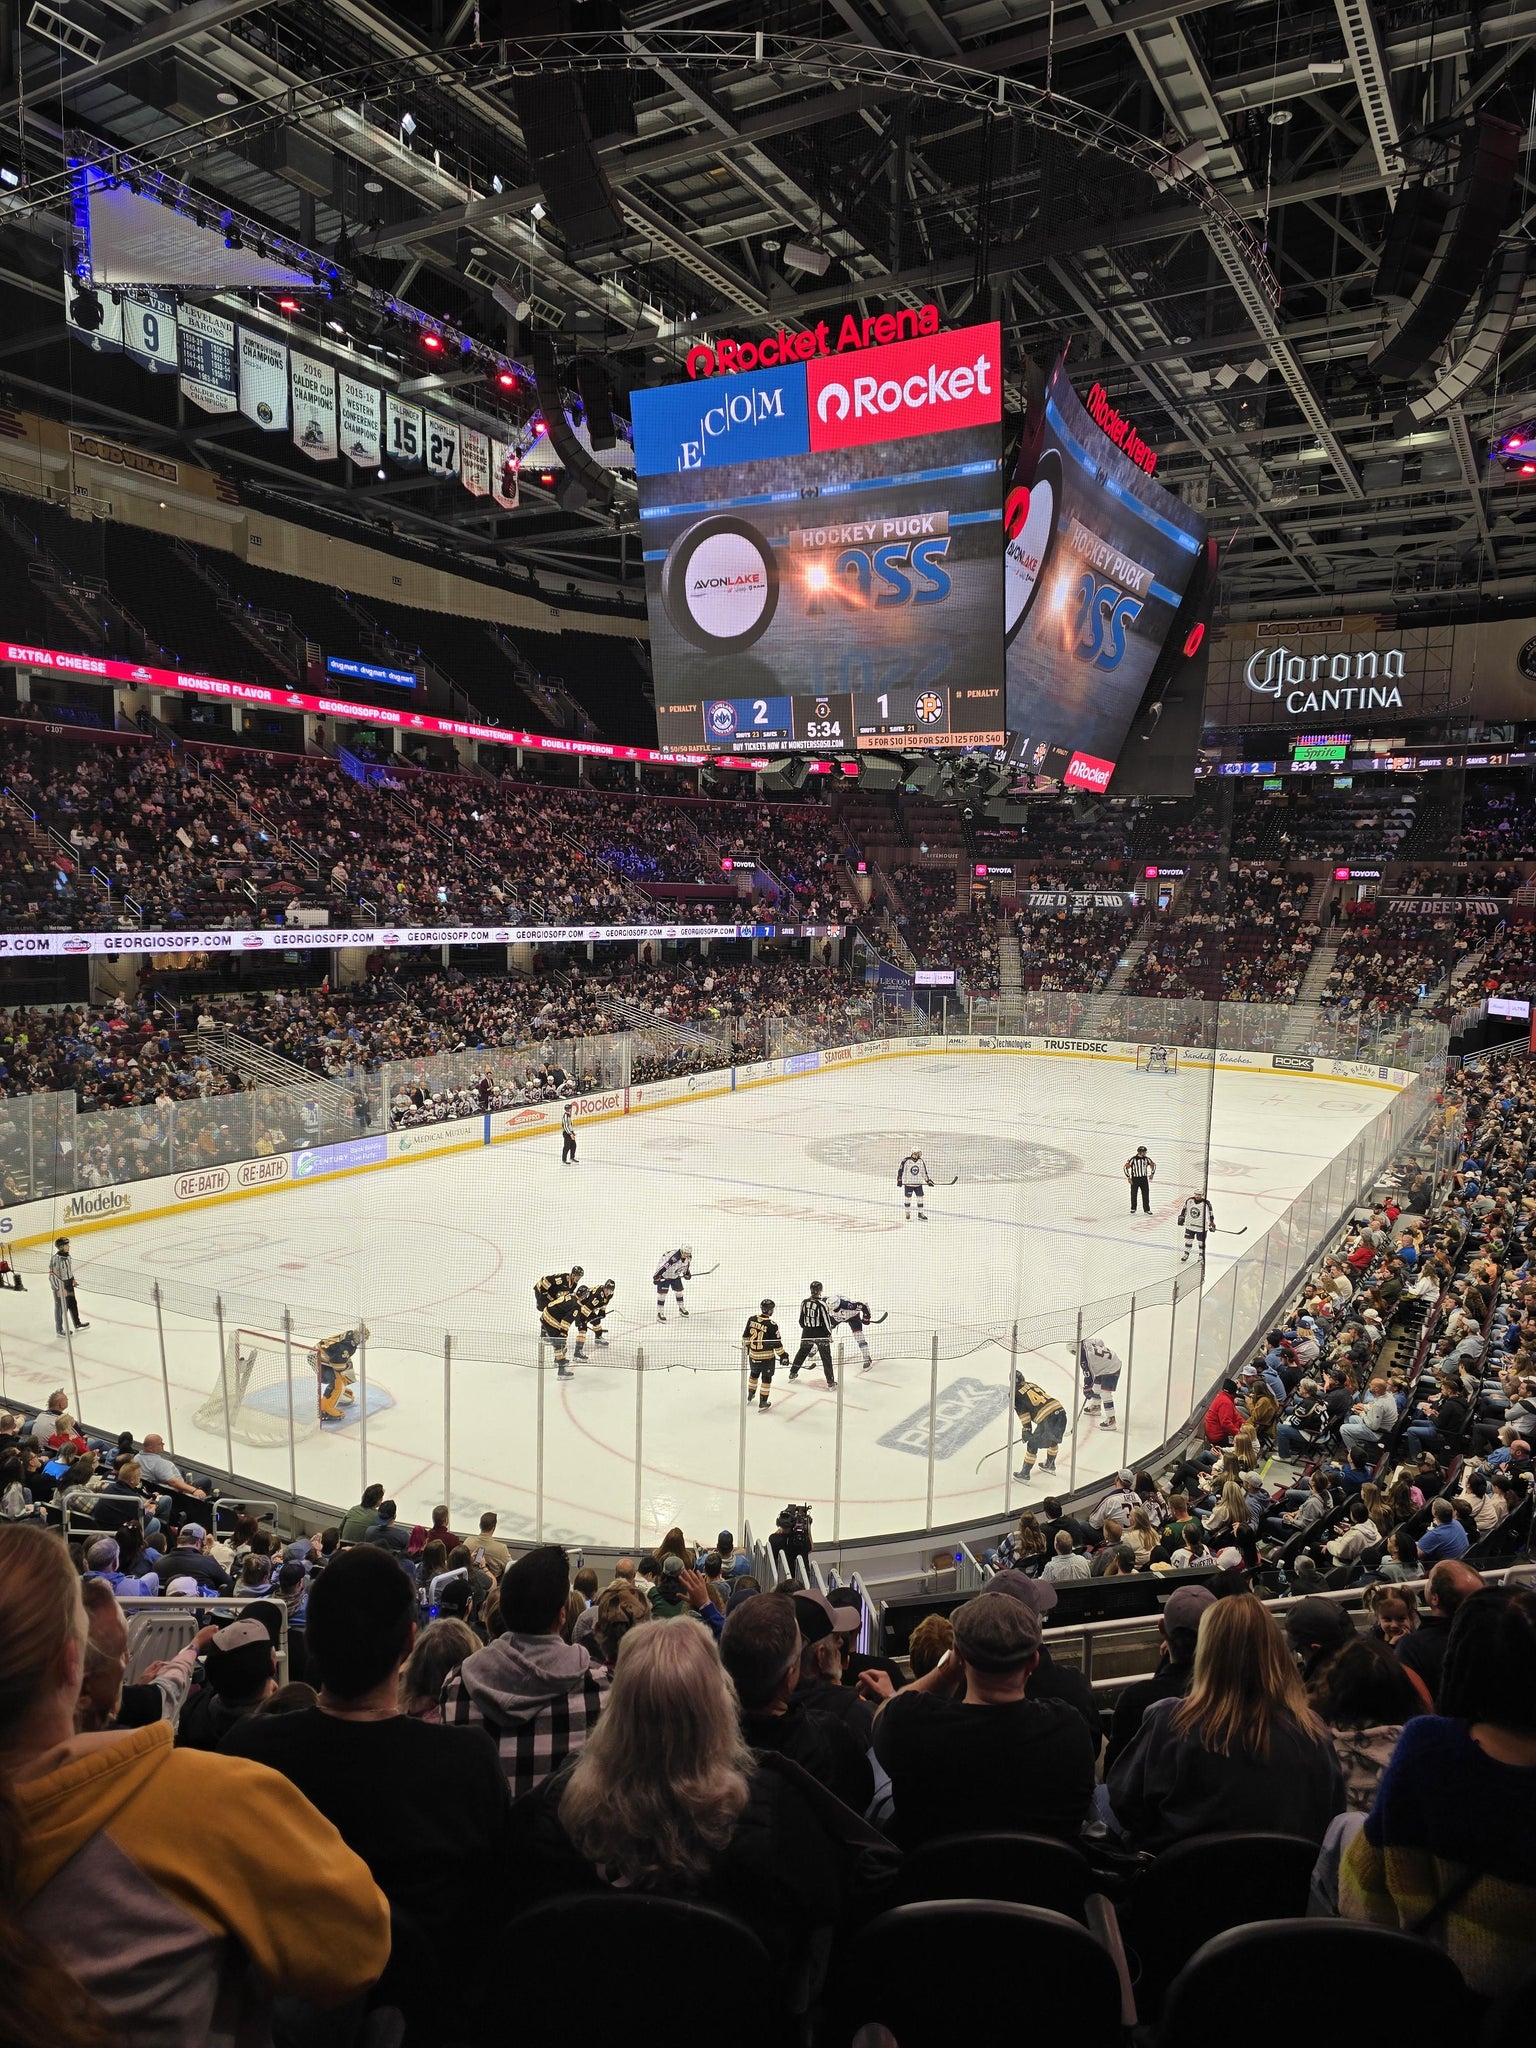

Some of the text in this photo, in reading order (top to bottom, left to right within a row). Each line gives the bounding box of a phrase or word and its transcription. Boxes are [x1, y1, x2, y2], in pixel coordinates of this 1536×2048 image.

[180, 305, 232, 332] CLEVELAND
[188, 317, 225, 338] BARONS
[142, 313, 159, 352] 9
[717, 303, 939, 375] Rocket Arena
[242, 345, 284, 370] CHAMPIONS
[303, 363, 322, 379] 2016
[189, 385, 229, 403] CALDER CUP
[293, 373, 333, 397] CALDER CUP
[345, 383, 375, 404] 2015-16
[854, 354, 992, 418] Rocket
[190, 391, 229, 410] CHAMPIONS
[294, 387, 333, 411] CHAMPIONS
[346, 398, 374, 416] WESTERN
[342, 408, 379, 431] CONFERENCE
[389, 402, 420, 419] CALLANDER
[344, 420, 377, 441] CHAMPIONS
[393, 417, 417, 455] 15
[1092, 389, 1129, 448] Rocket
[1123, 424, 1159, 475] Arena
[72, 434, 178, 483] LOUDVILLE
[430, 433, 455, 470] 27
[74, 486, 88, 496] 210
[250, 536, 262, 545] 211
[801, 515, 934, 548] HOCKEY PUCK
[1071, 529, 1145, 591] HOCKEY PUCK
[1259, 619, 1341, 636] LOUDVILLE
[8, 646, 107, 674] EXTRA CHEESE
[1243, 644, 1408, 699] Corona
[177, 675, 272, 700] MONSTER FLAVOR
[967, 688, 1000, 698] PENALTY
[669, 704, 697, 713] PENALTY
[877, 693, 889, 719] 1
[1285, 686, 1404, 714] CANTINA
[318, 699, 401, 723] GEORGIOSOFP.COM
[752, 699, 769, 725] 2
[44, 725, 64, 734] C 107
[437, 720, 514, 742] TRY THE MONSTERONI
[807, 721, 841, 738] 5:34
[907, 724, 915, 732] 21
[541, 738, 614, 755] DOUBLE PEPPERONI
[732, 743, 744, 752] BUY
[744, 741, 767, 751] TICKETS
[766, 741, 780, 750] NOW
[780, 740, 788, 748] AT
[868, 733, 1001, 746] 5 FOR $10 50 FOR $20 125 FOR $40
[1020, 738, 1030, 757] 1
[1303, 747, 1336, 759] Sprite
[1077, 762, 1111, 786] Rocket
[1206, 766, 1213, 774] 7
[1250, 763, 1260, 774] 2
[1291, 761, 1317, 772] 5:34
[1371, 758, 1379, 769] 1
[1418, 759, 1442, 767] SHOTS
[1446, 757, 1454, 766] 8
[1466, 757, 1488, 765] SAVES
[1489, 755, 1502, 764] 21
[1350, 870, 1380, 878] TOYOTA
[1029, 894, 1123, 908] THE END
[1388, 900, 1418, 914] THE
[1465, 903, 1500, 916] END
[104, 936, 232, 949] GEORGIOSOFP.COM
[273, 933, 375, 945] GEORGIOSOFP.COM
[407, 931, 490, 942] GEORGIOSOFP.COM
[516, 929, 584, 940] GEORGIOSOFP.COM
[605, 927, 663, 938] GEORGIOSOFP.COM
[680, 926, 735, 937] GEORGIOSOFP.COM
[764, 927, 770, 936] 7
[805, 927, 815, 936] 21
[996, 1038, 1032, 1049] Technologies
[1044, 1039, 1108, 1053] TRUSTEDSEC
[825, 1049, 852, 1064] SEATGEEK
[1182, 1049, 1215, 1061] Sandals
[1350, 1065, 1376, 1078] BARONS
[580, 1093, 620, 1115] Rocket
[514, 1113, 540, 1124] SERVPRO
[413, 1127, 472, 1145] MEDICAL MUTUAL
[71, 1191, 123, 1217] Modelo
[750, 1328, 763, 1350] 21
